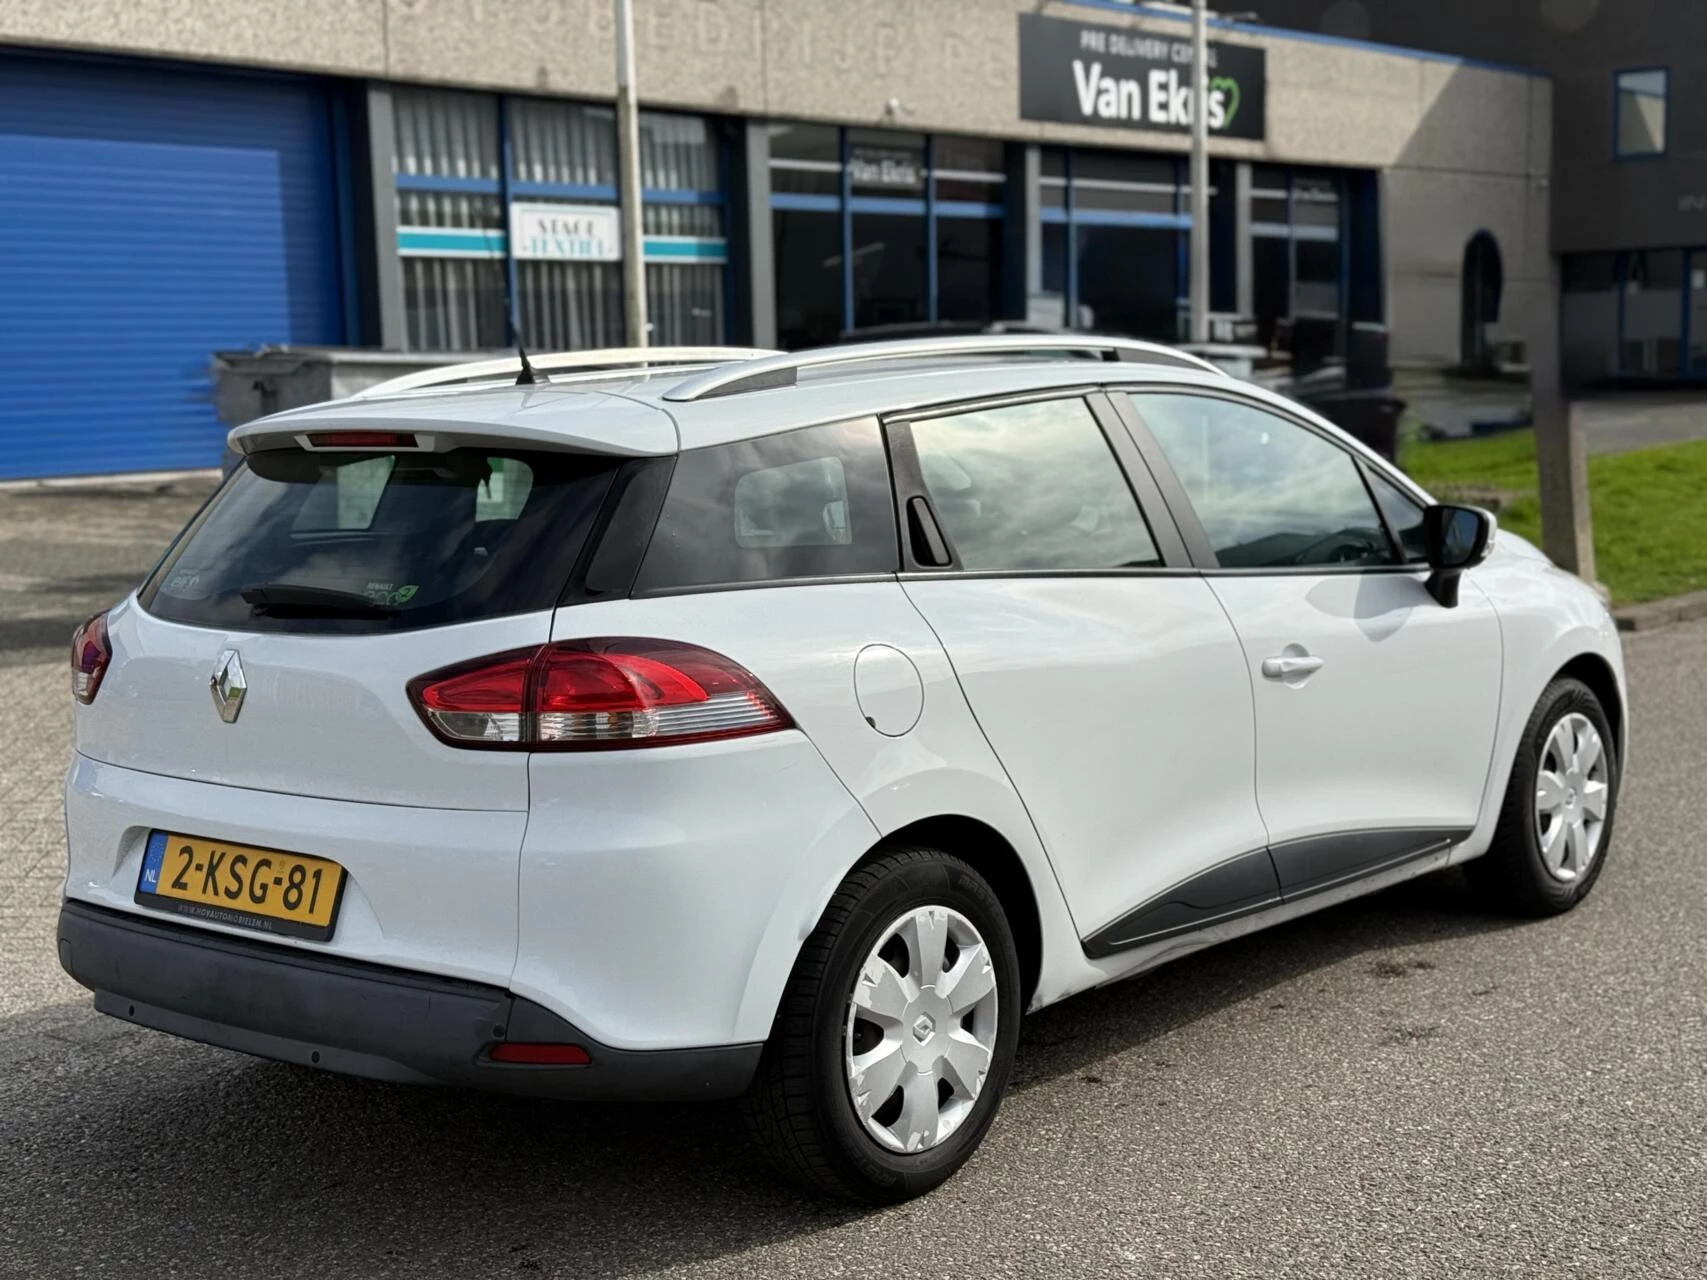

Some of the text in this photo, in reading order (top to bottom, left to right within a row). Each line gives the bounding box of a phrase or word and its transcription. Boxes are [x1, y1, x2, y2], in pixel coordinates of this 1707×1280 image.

[1081, 30, 1106, 53] PRE
[1109, 34, 1168, 60] DELIVERY
[1072, 59, 1141, 120] Van
[144, 871, 157, 884] NL
[171, 845, 323, 914] 2-KSG-81
